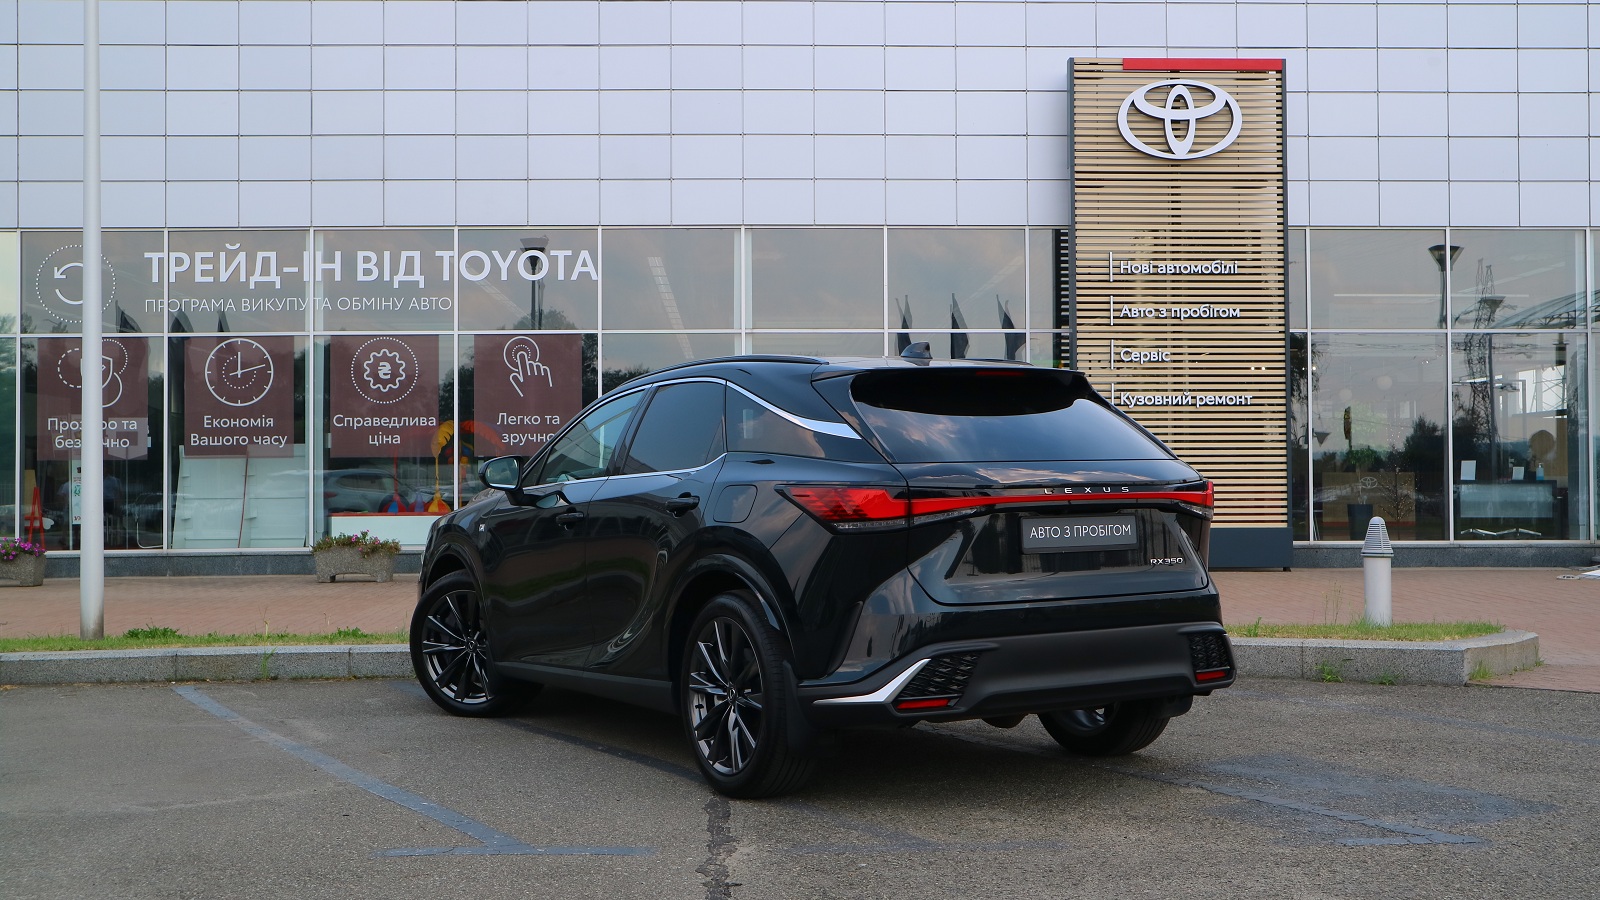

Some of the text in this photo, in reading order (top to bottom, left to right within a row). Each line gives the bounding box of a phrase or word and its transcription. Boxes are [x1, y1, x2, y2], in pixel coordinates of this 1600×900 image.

[144, 243, 598, 289] ТРЕЙД-ІН ВІД TOYOTA
[1120, 260, 1238, 275] Нові автомобілі
[145, 297, 452, 312] ПРОГРАМА ВИКУПУ ТА ОБМІНУ АВТО
[1120, 304, 1241, 320] Авто з пробігом
[1120, 348, 1171, 364] Сервіс
[1120, 392, 1253, 409] Кузовний ремонт
[121, 420, 137, 430] та
[203, 415, 274, 428] Економія
[333, 414, 436, 429] Справедлива
[496, 412, 560, 425] Легко та
[55, 435, 130, 448] безчно
[190, 434, 287, 448] Вашого часу
[368, 432, 400, 445] ціна
[1044, 486, 1129, 495] LEXUS
[1030, 526, 1061, 539] АВТО
[1074, 524, 1132, 537] ПРОБІГОМ
